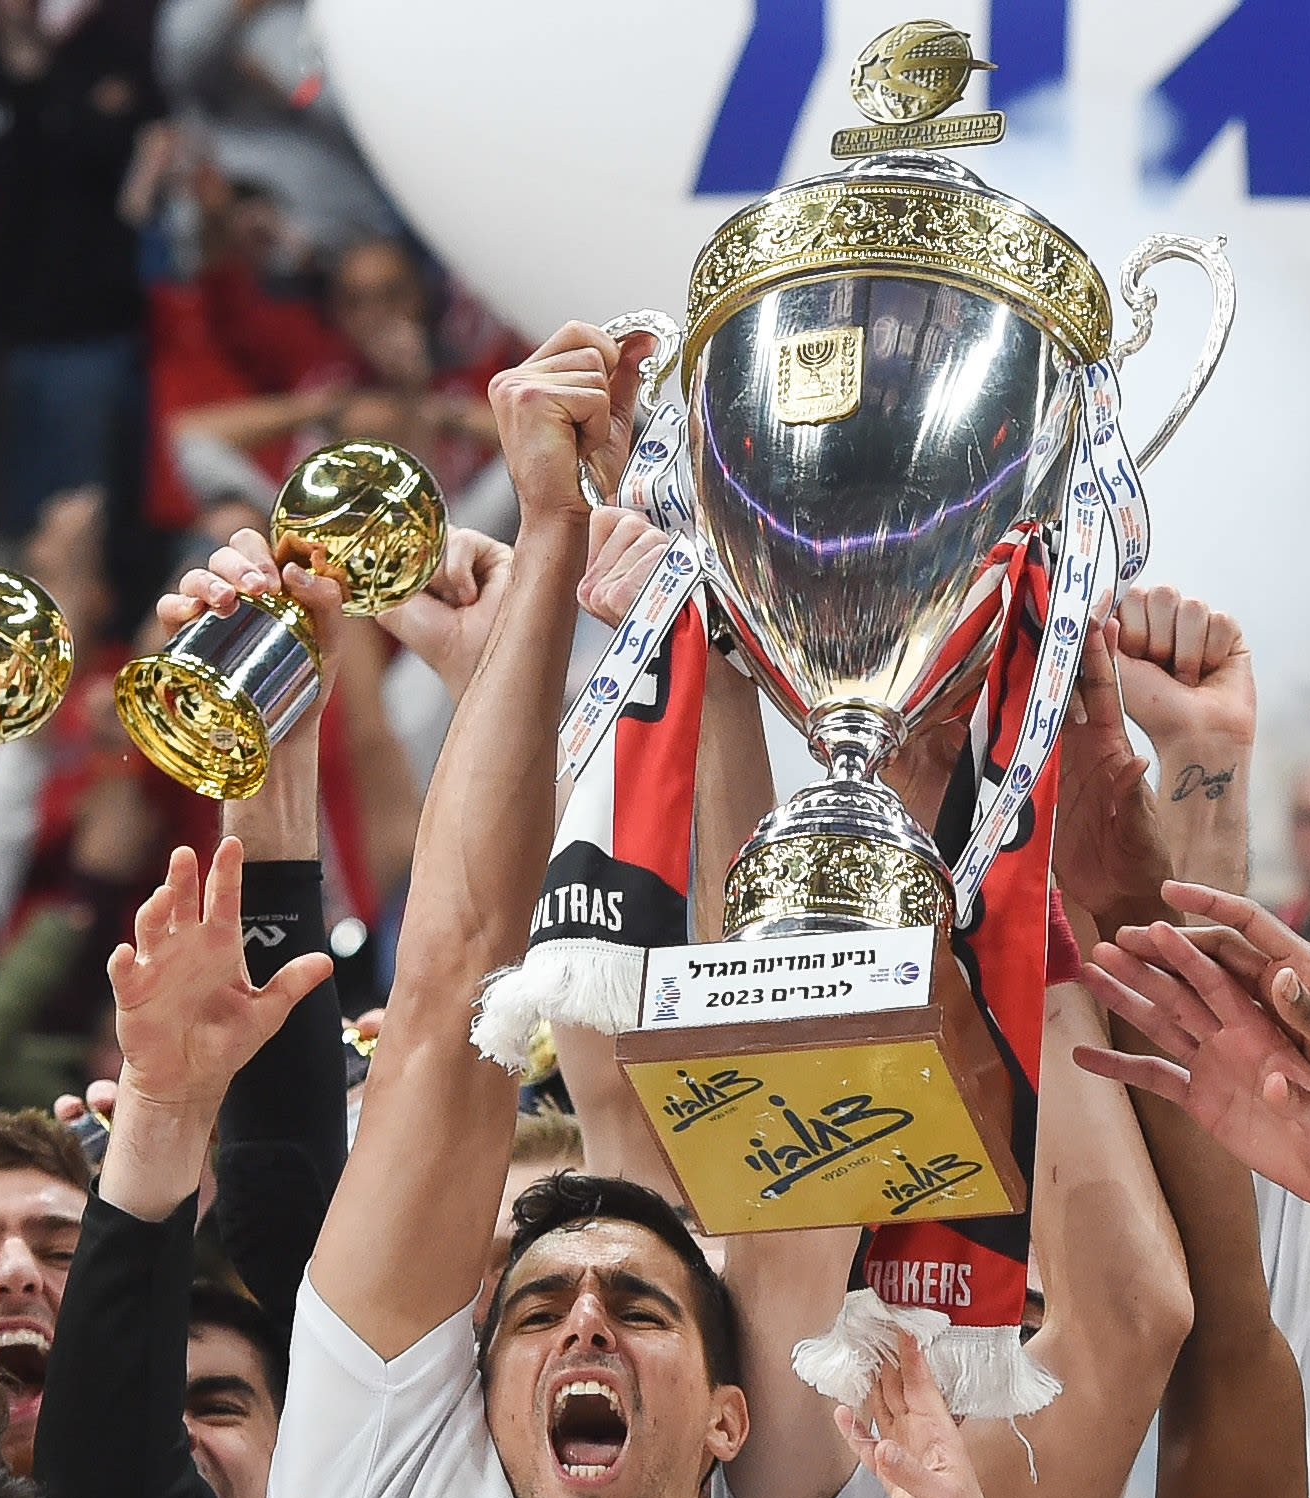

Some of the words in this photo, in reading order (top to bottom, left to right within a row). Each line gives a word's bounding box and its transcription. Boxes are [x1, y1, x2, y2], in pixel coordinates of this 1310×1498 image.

[530, 883, 624, 938] ULTRAS
[688, 959, 748, 980] מגדל
[752, 953, 826, 975] המדינה
[831, 949, 877, 969] גביע
[705, 988, 765, 1008] 2023
[771, 980, 853, 1003] לגברים
[867, 1260, 972, 1307] ORKERS
